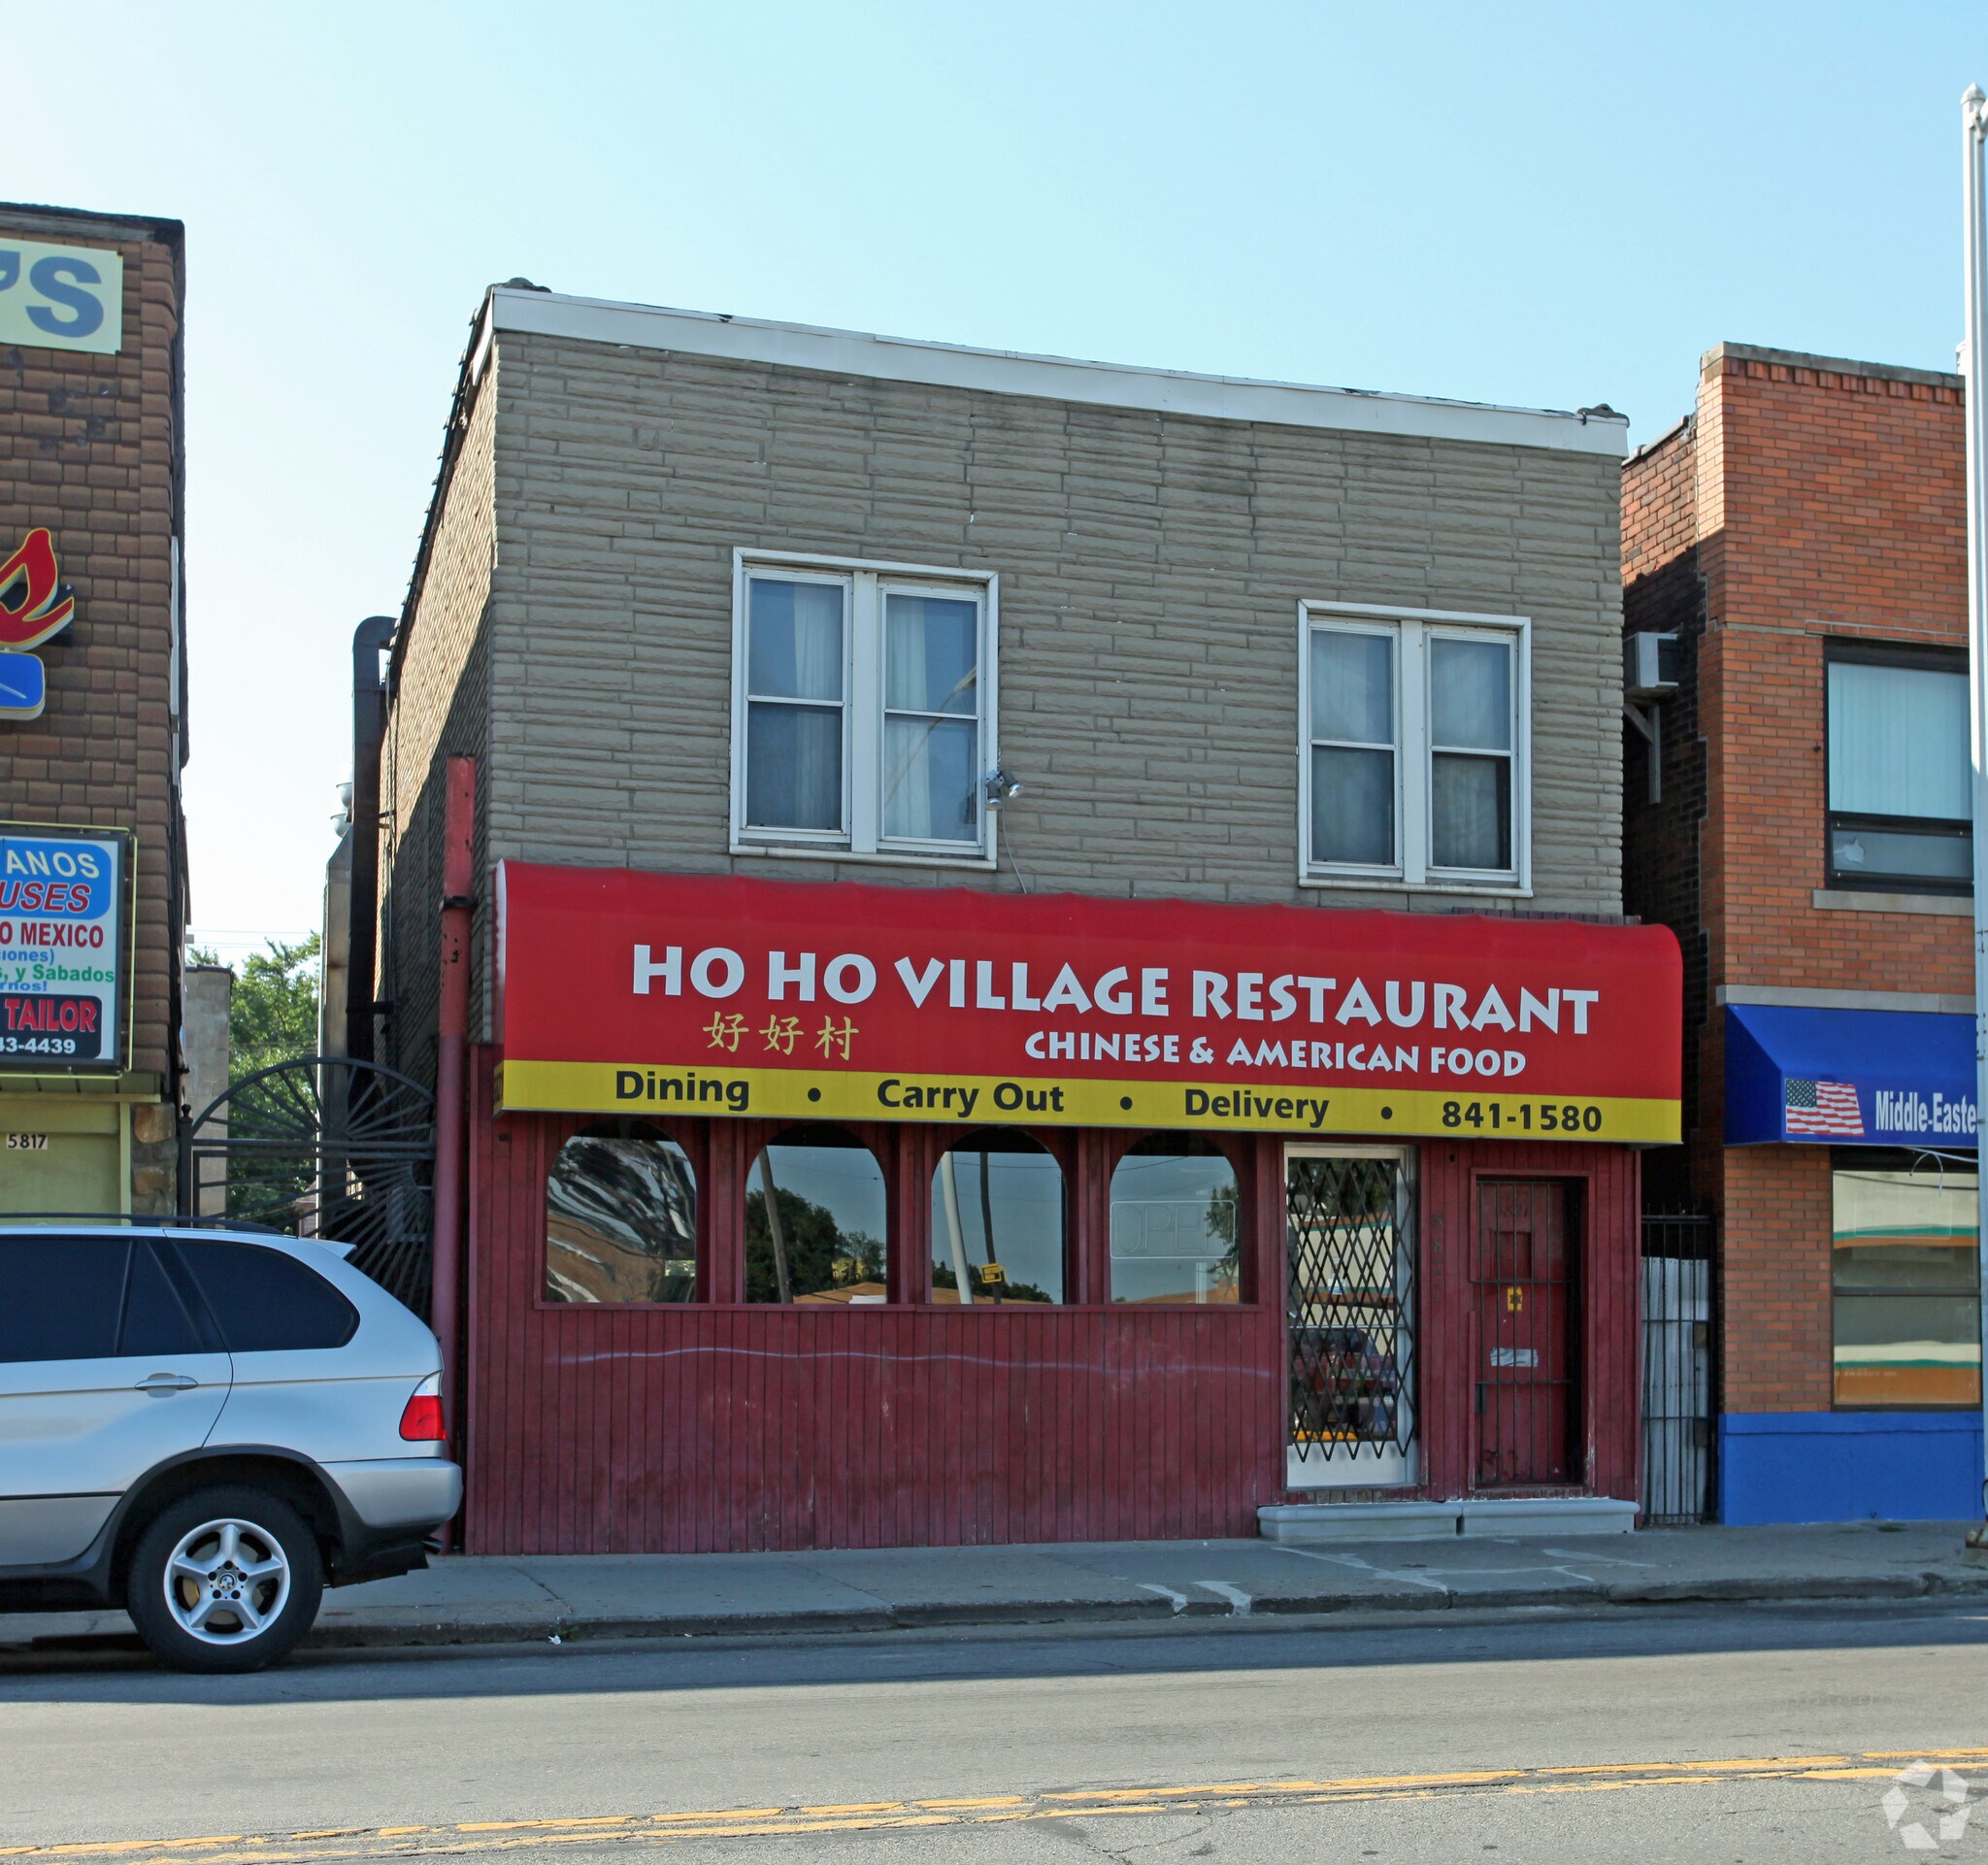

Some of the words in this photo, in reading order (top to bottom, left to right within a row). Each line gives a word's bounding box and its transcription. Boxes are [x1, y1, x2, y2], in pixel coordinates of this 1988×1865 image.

[20, 922, 104, 948] MEXICO
[0, 949, 54, 966] iones)
[16, 967, 26, 982] y
[33, 964, 115, 982] Sabados
[633, 944, 746, 998] HO
[768, 950, 877, 1004] HO
[894, 956, 1170, 1016] VILLAGE
[1192, 968, 1599, 1036] RESTAURANT
[5, 998, 97, 1033] TAILOR
[702, 1011, 859, 1061] 好好村
[1025, 1030, 1179, 1064] CHINESE
[1189, 1036, 1214, 1064] &
[1226, 1037, 1419, 1073] AMERICAN
[1431, 1047, 1526, 1077] FOOD
[615, 1071, 749, 1112] Dining
[878, 1080, 978, 1116] Carry
[993, 1082, 1064, 1112] Out
[1184, 1088, 1329, 1128] Delivery
[1441, 1101, 1603, 1132] 841-1580
[1875, 1090, 1978, 1134] Middle-Easte
[8, 1134, 48, 1149] 5817
